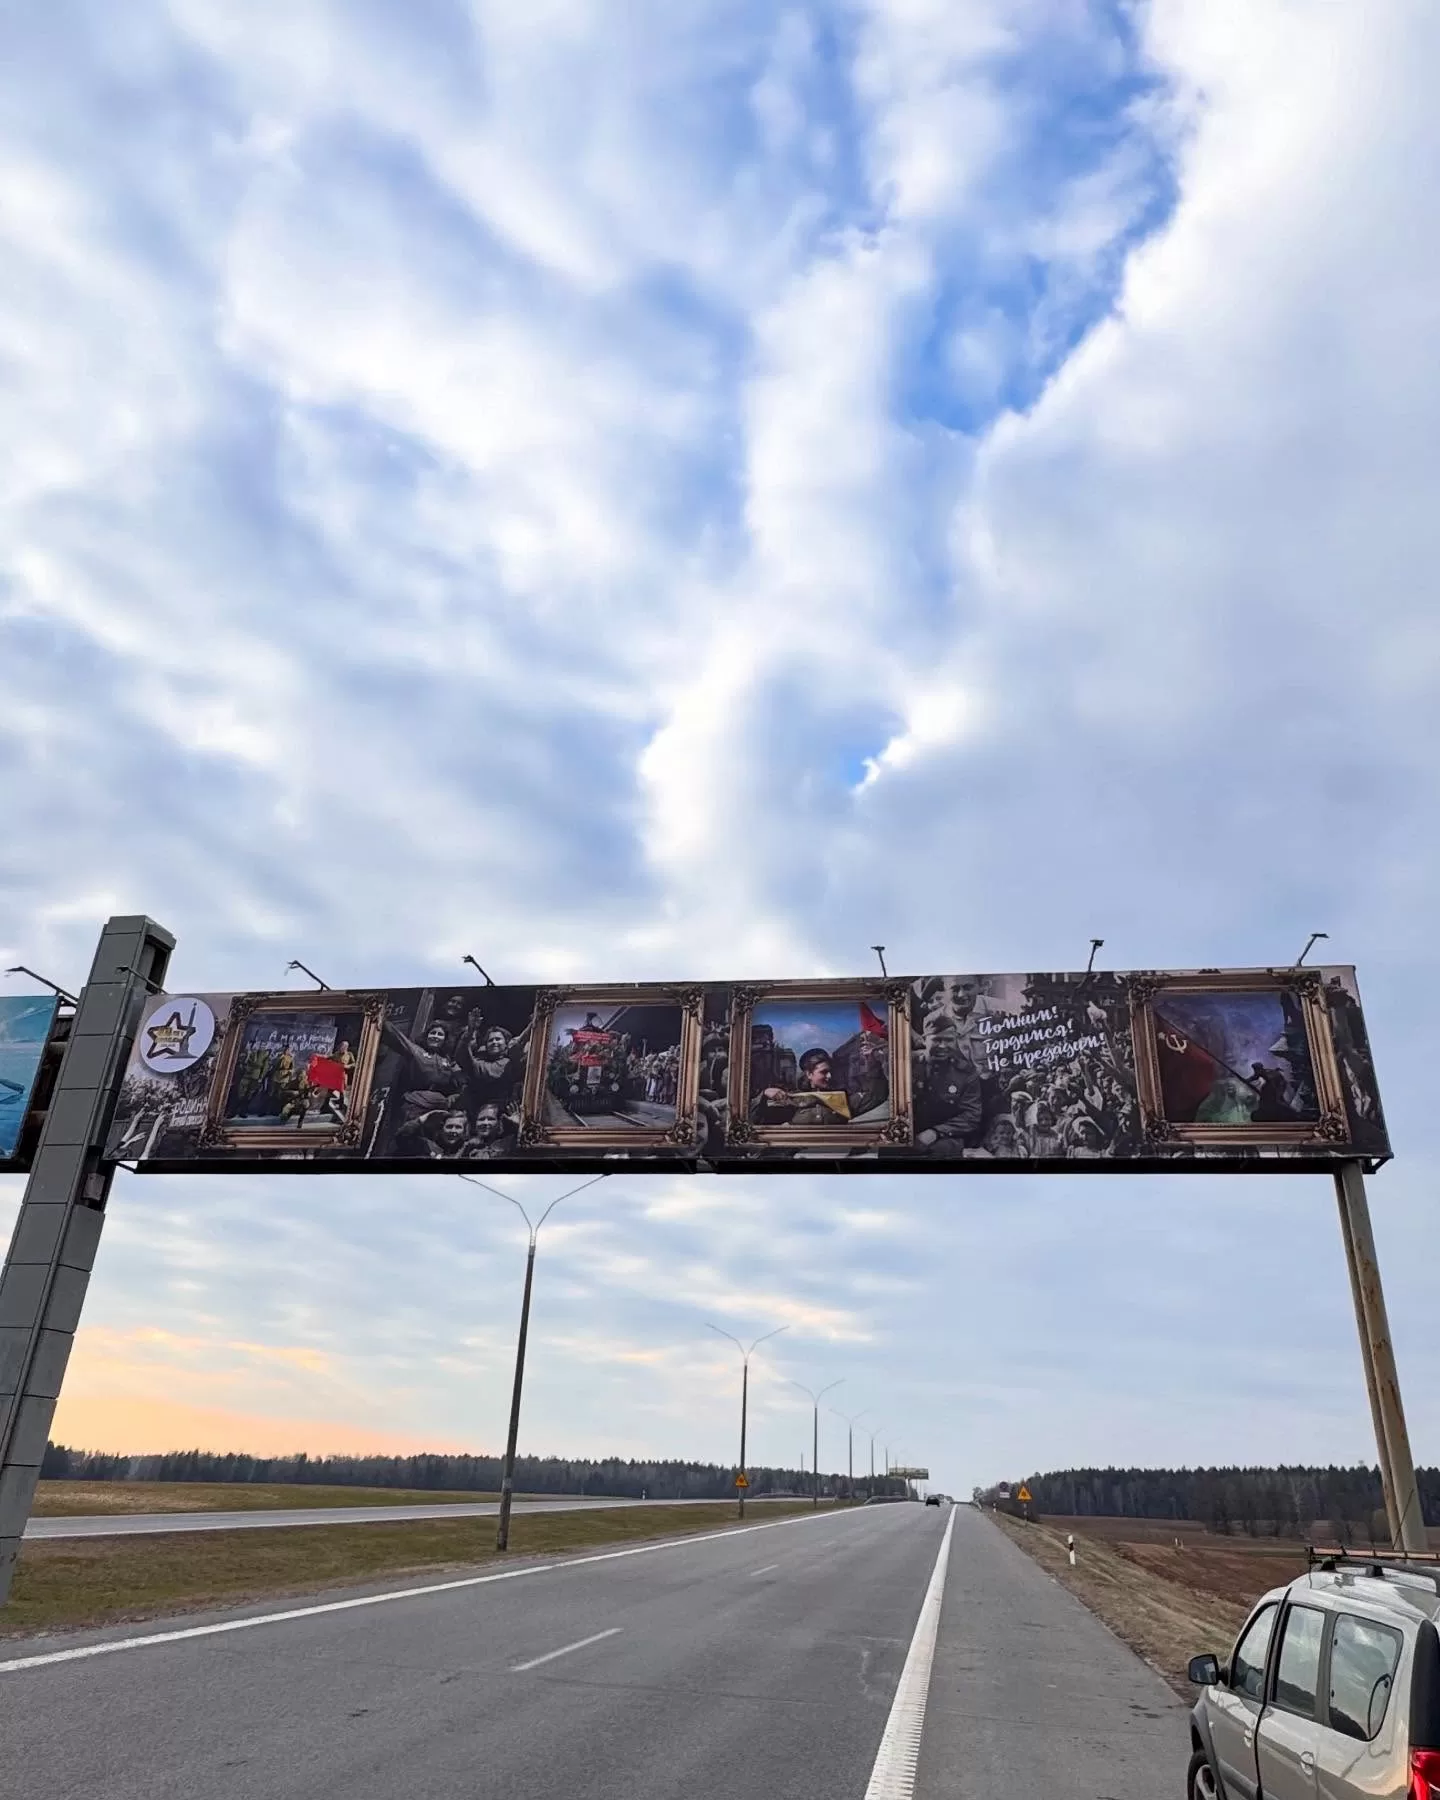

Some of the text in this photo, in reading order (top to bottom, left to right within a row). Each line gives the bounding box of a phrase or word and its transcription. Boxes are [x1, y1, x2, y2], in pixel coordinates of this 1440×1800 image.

[978, 1005, 1058, 1035] Помним!
[983, 1018, 1074, 1054] Гордимся!
[987, 1032, 1106, 1072] Не предадим!
